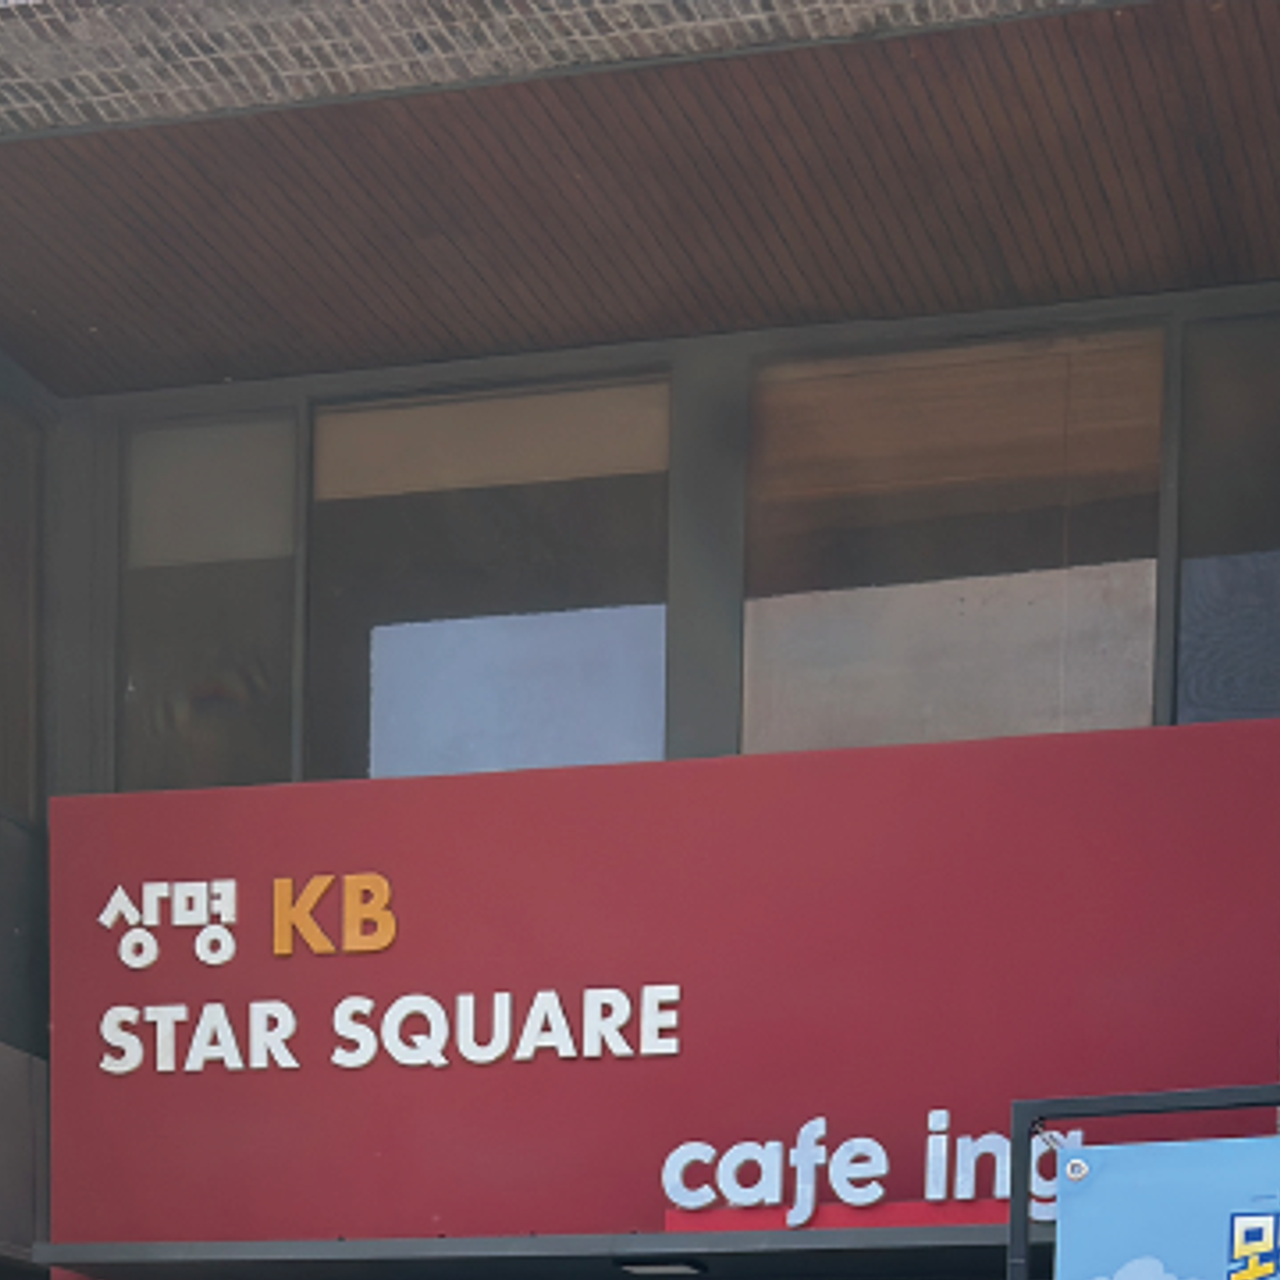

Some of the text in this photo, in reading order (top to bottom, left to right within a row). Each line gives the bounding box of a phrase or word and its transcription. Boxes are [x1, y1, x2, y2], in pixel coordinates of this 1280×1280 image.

[97, 872, 398, 969] 상명 KB
[98, 984, 681, 1075] STAR SQUARE
[661, 1116, 889, 1228] cafe
